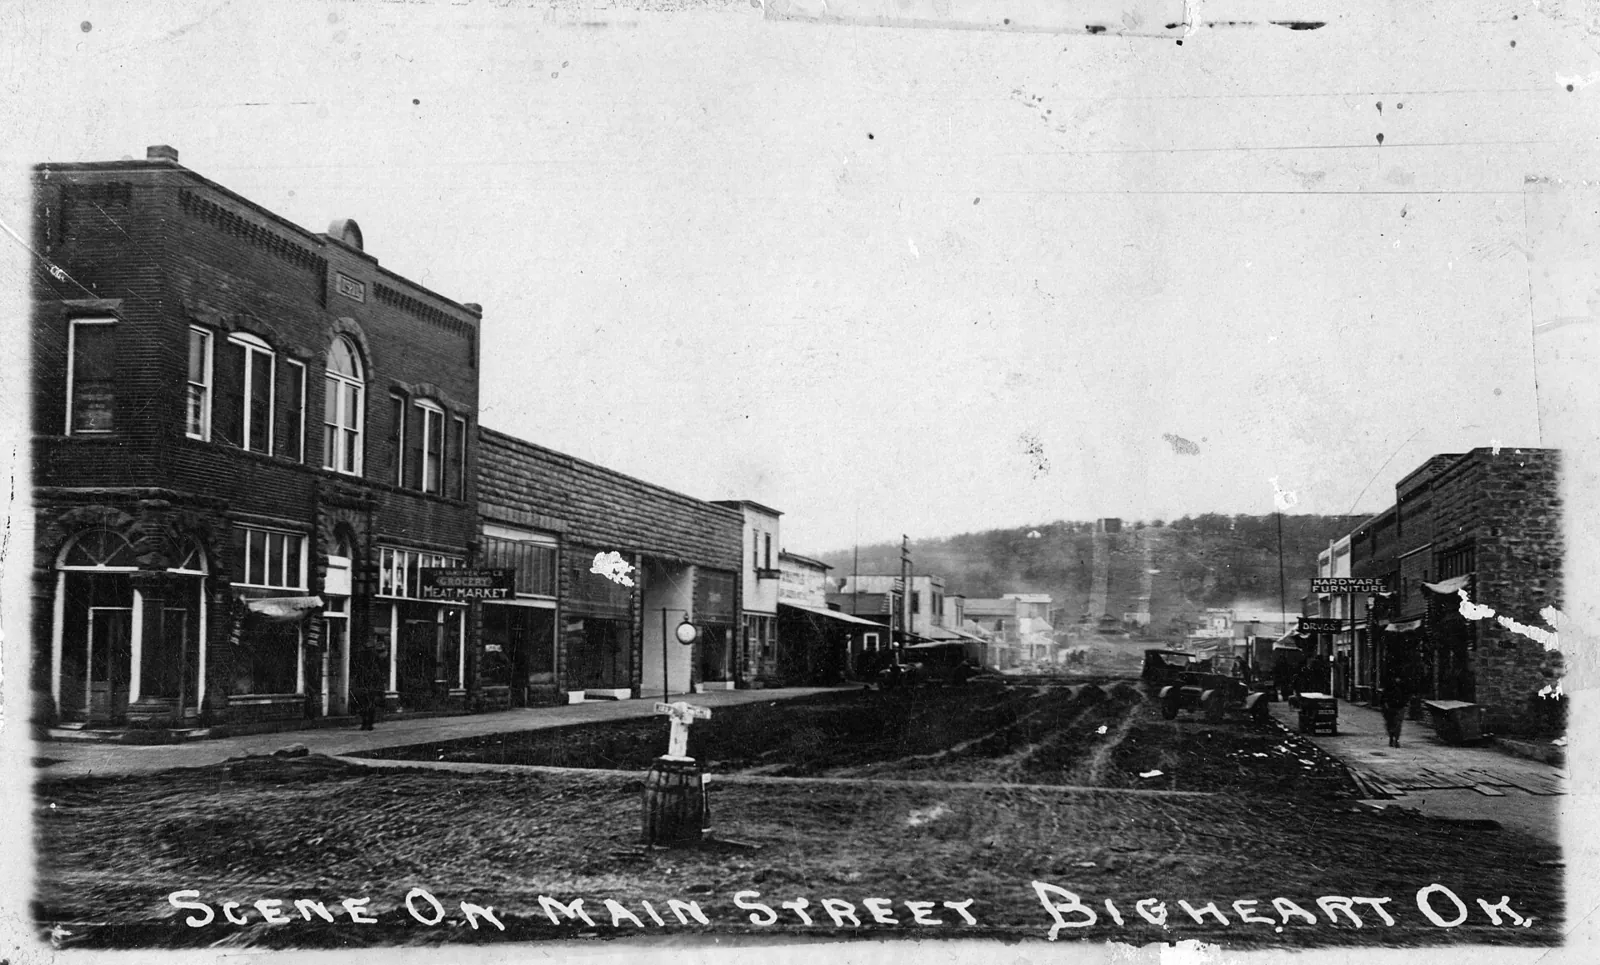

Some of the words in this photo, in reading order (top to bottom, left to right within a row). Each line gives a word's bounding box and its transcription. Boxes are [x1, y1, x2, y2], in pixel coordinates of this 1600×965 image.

[438, 576, 490, 587] GROCERY
[1313, 578, 1383, 586] HARDWARE
[423, 585, 453, 598] MEAT
[456, 588, 508, 598] MARKET
[1312, 585, 1387, 593] FURNITURE
[1302, 622, 1336, 631] DRUGS
